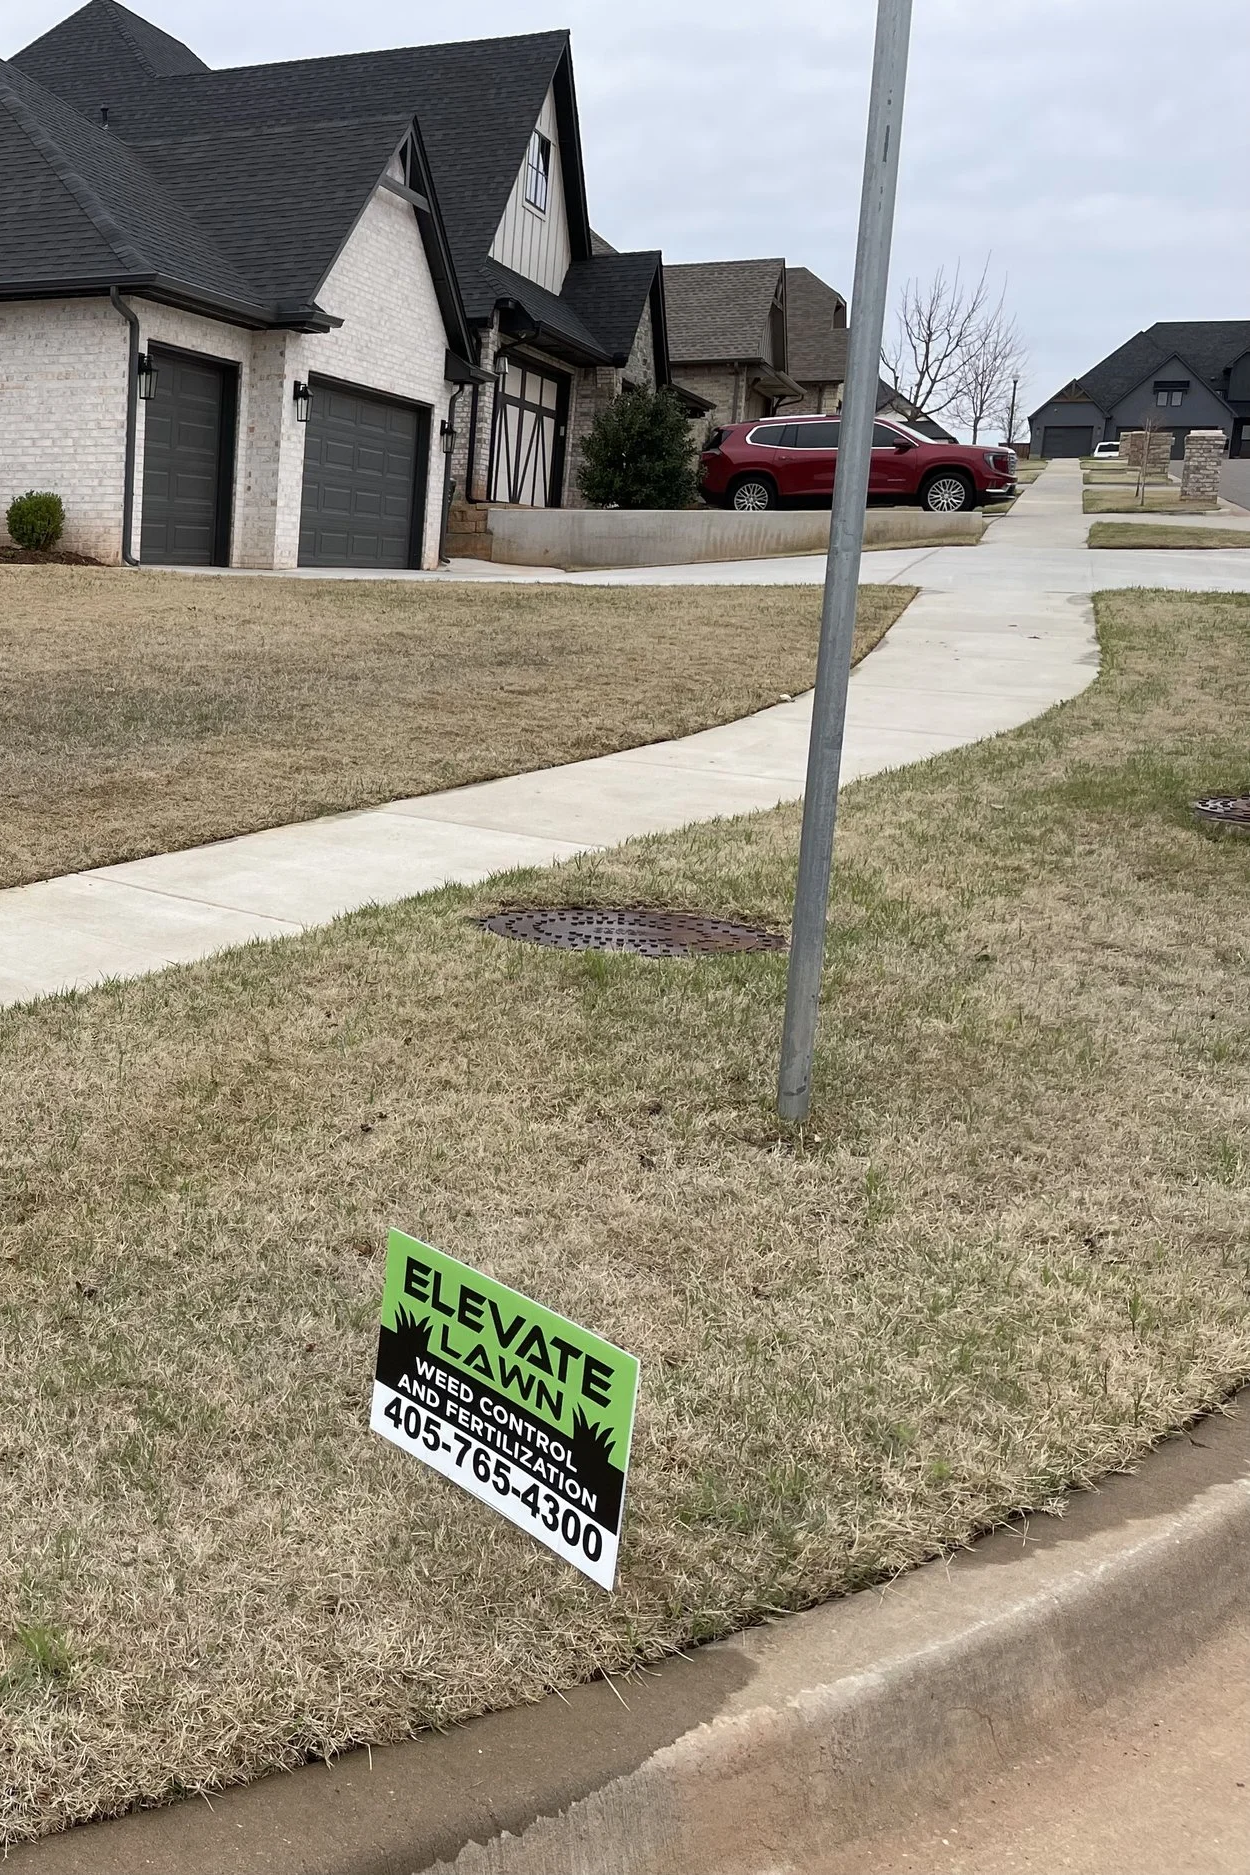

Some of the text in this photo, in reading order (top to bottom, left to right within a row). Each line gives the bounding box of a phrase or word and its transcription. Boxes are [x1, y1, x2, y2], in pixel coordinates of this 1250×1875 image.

[403, 1256, 615, 1408] ELEVATE
[440, 1323, 564, 1421] LAWN
[383, 1396, 602, 1562] 405-765-4300
[397, 1373, 598, 1513] AND FERTILIZATION
[415, 1356, 578, 1473] WEED CONTROL
